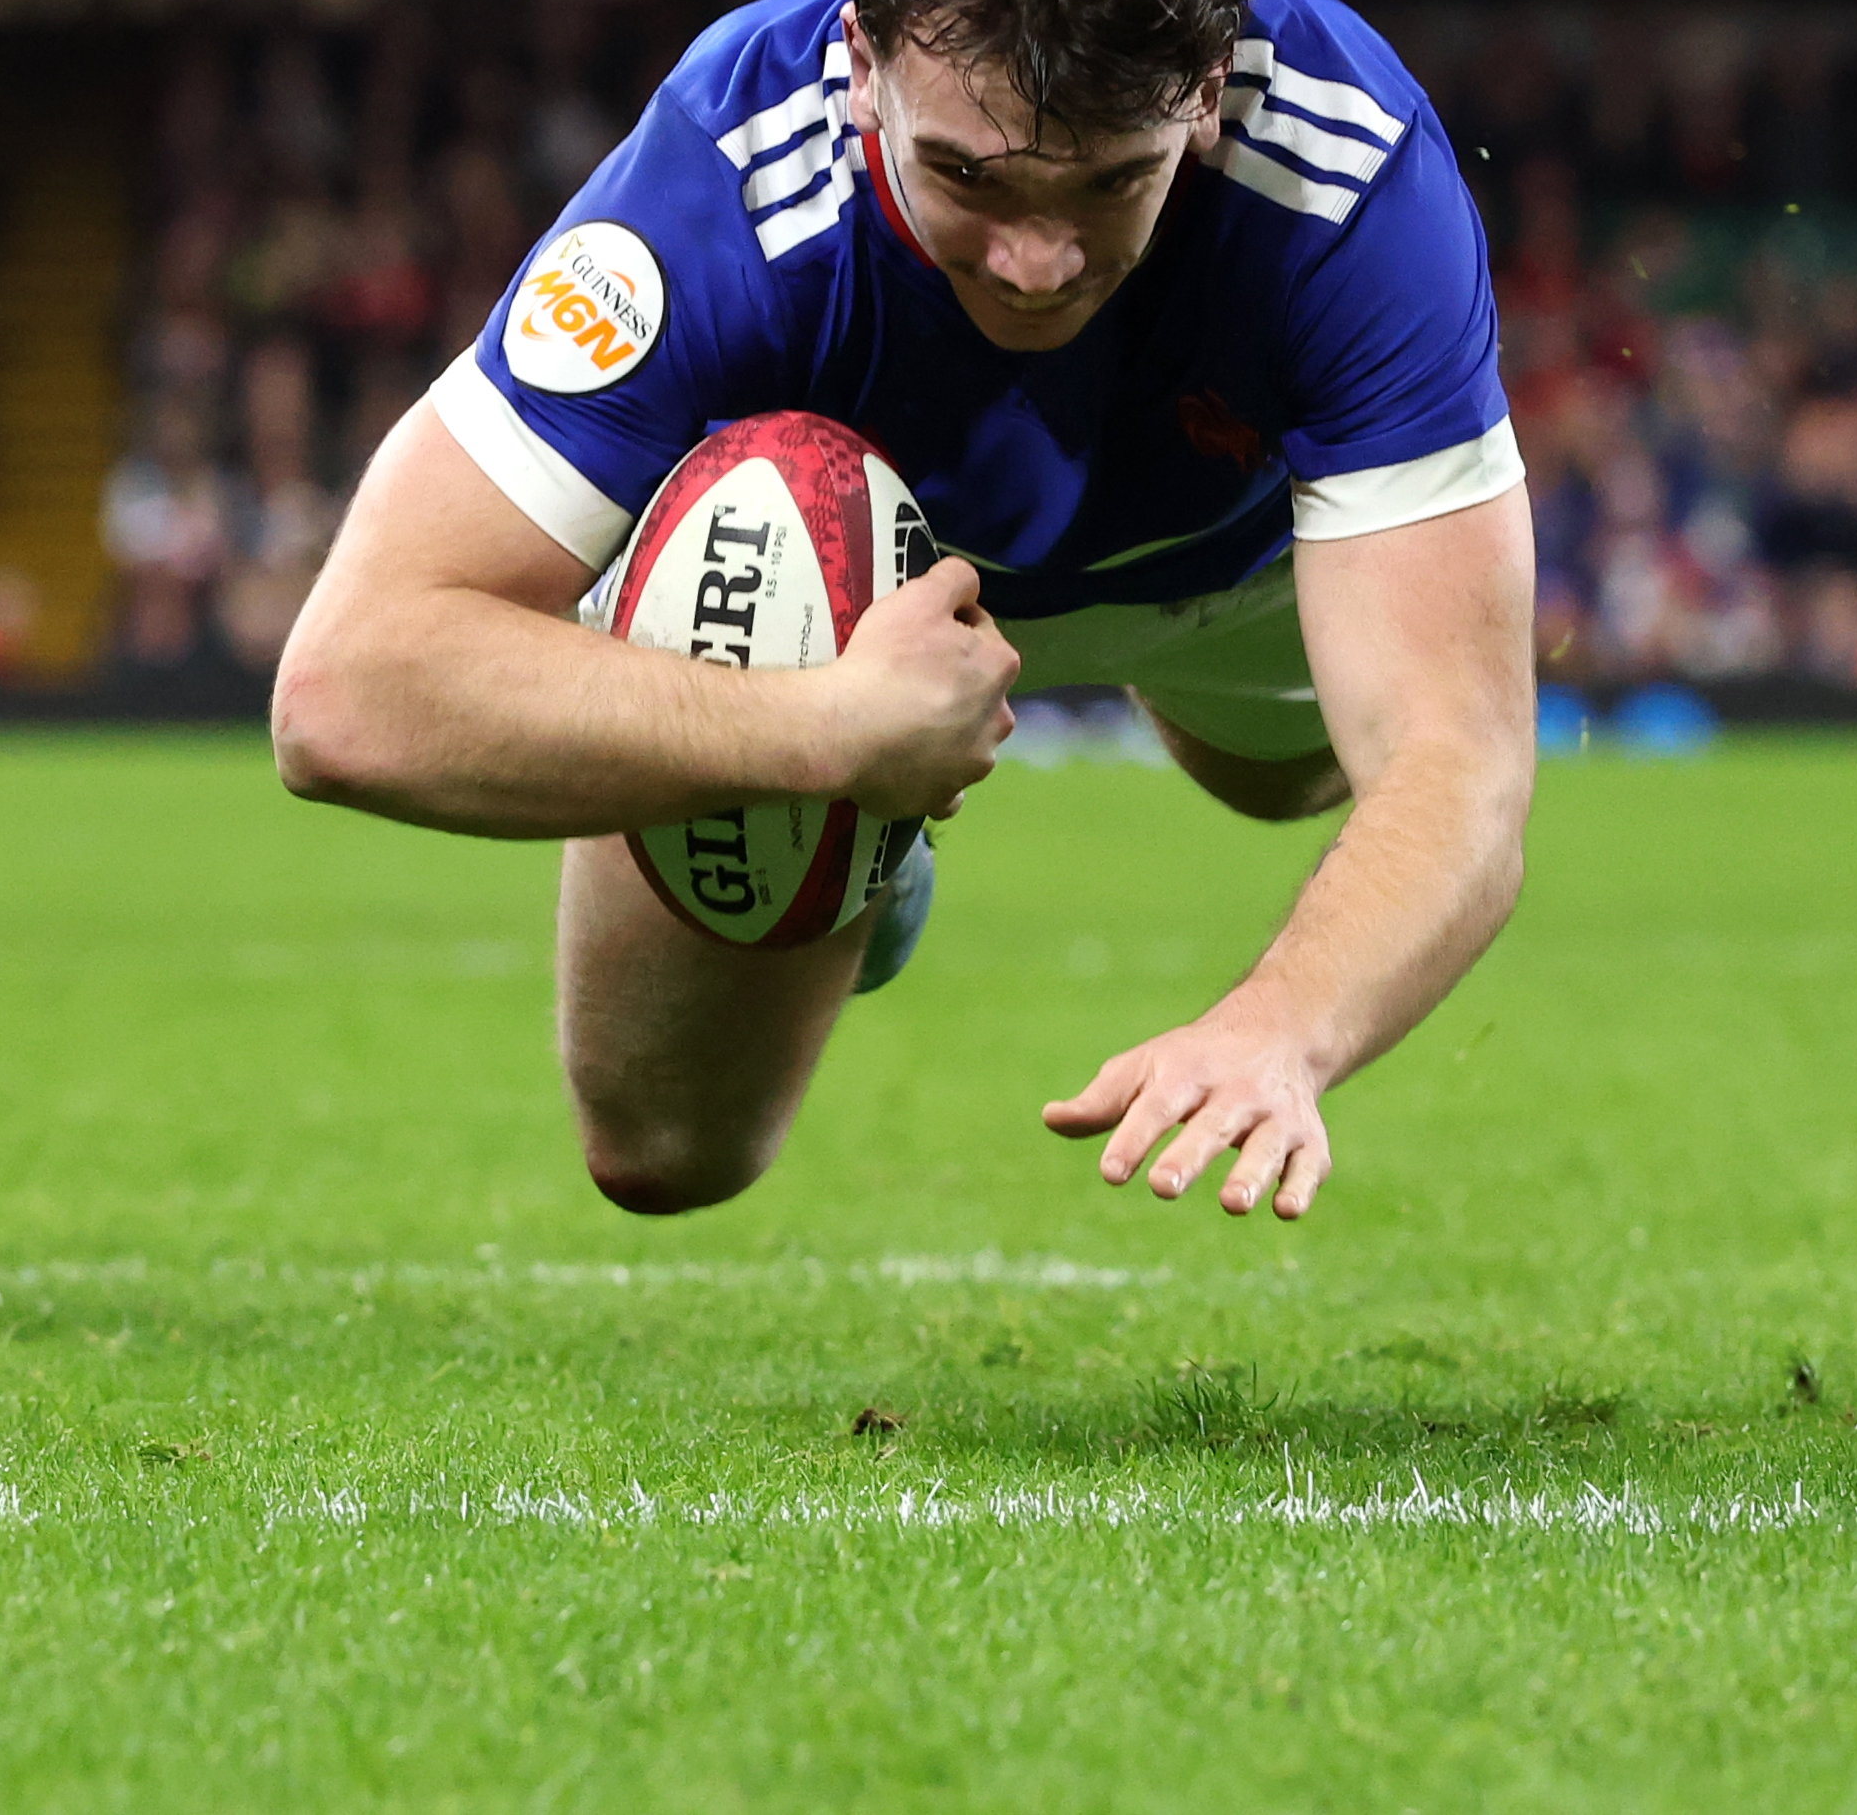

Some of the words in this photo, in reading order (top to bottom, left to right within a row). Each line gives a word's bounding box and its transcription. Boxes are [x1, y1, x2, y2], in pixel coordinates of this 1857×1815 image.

[521, 270, 637, 372] M6N
[572, 253, 653, 341] GUINNESS
[774, 526, 788, 548] PSI
[798, 602, 814, 670] atchball
